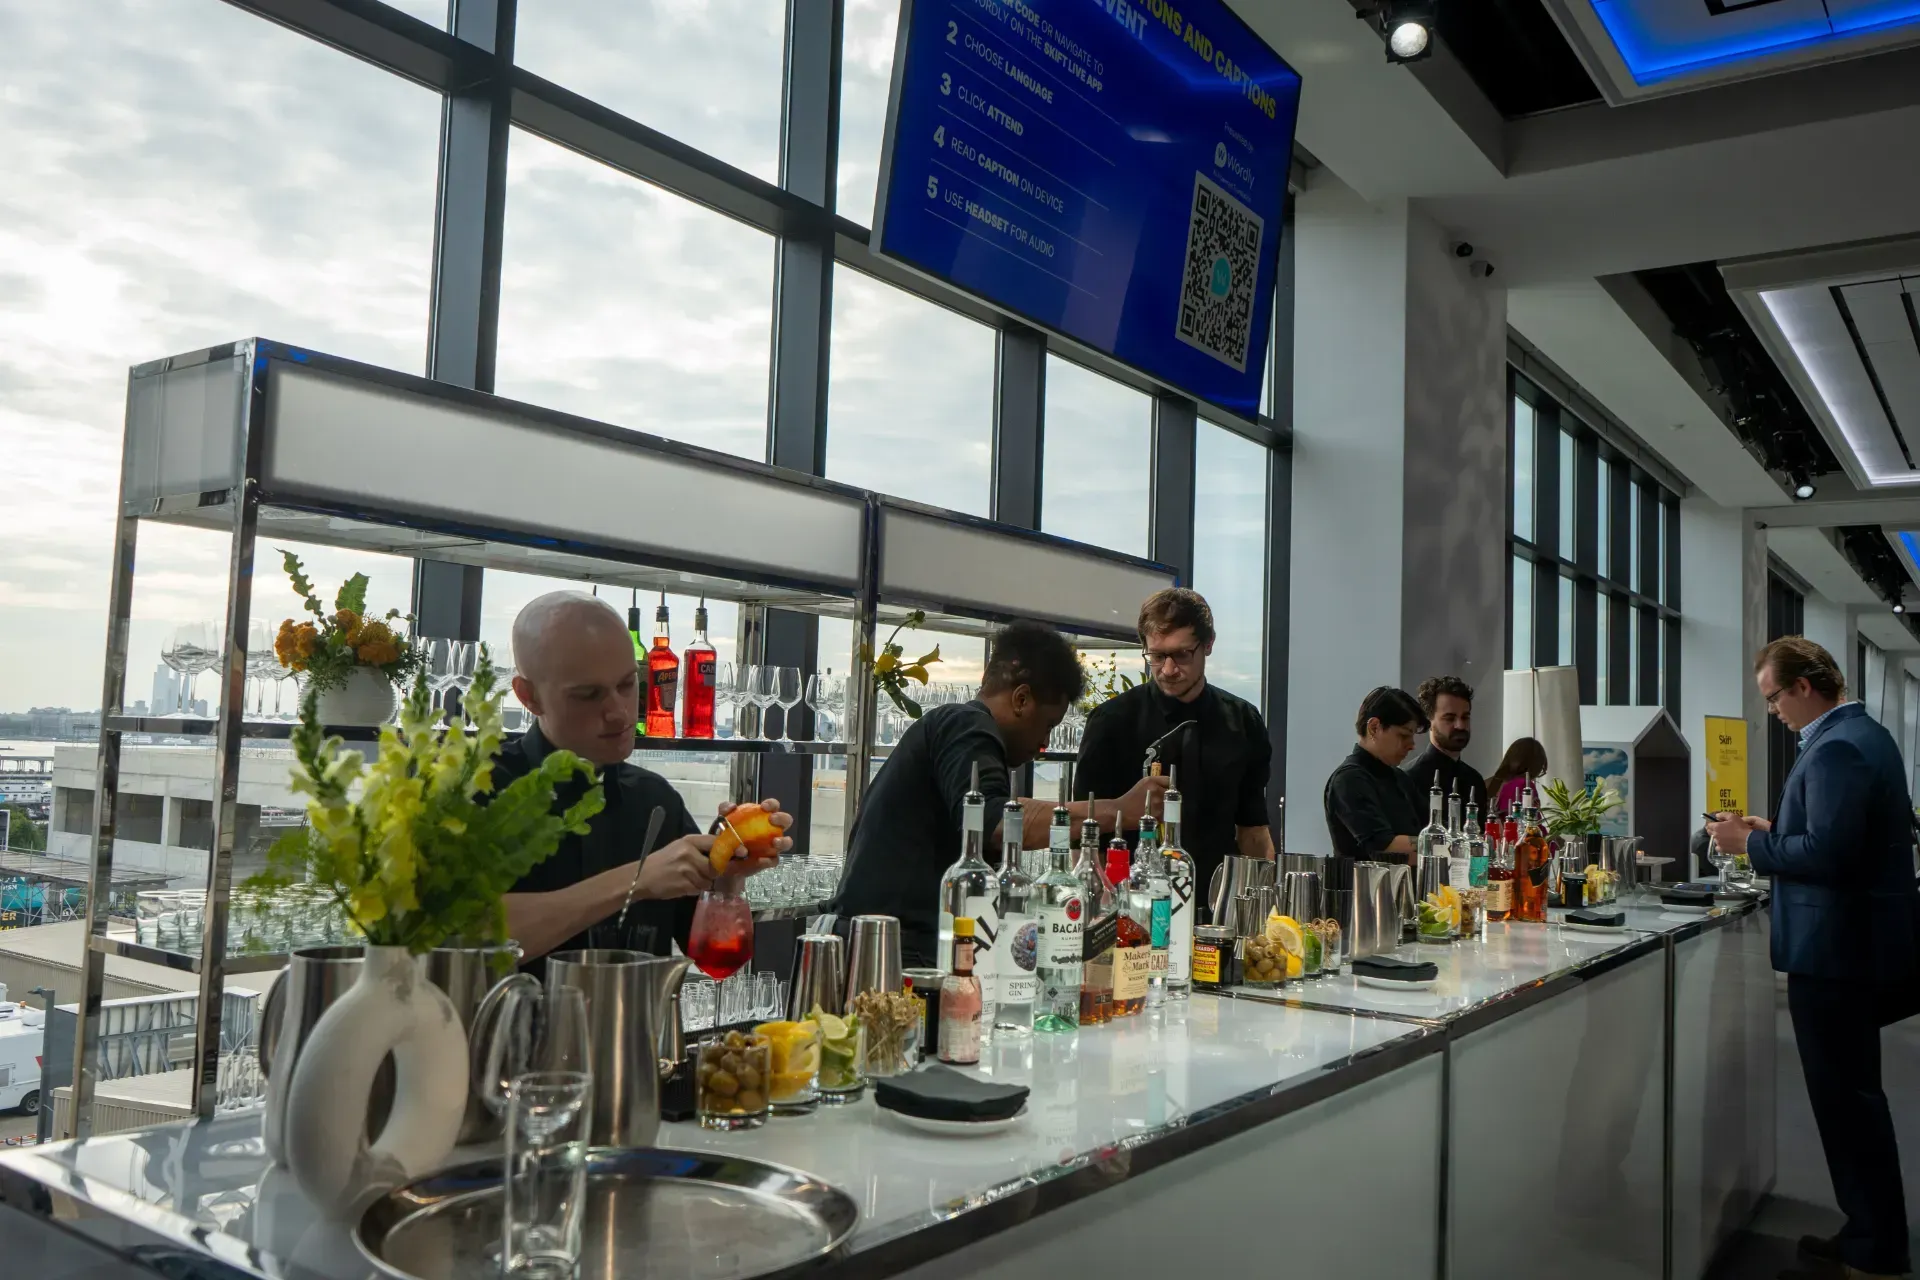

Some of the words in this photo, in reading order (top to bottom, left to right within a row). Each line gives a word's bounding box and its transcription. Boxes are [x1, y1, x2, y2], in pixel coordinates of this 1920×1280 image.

[946, 20, 958, 45] 2
[964, 34, 1004, 71] CHOOSE
[1005, 61, 1054, 104] LANGUAGE
[975, 0, 1009, 24] ORDLY
[1011, 17, 1024, 37] ON
[1026, 27, 1042, 51] THE
[1043, 42, 1068, 67] SKIFT
[1068, 60, 1087, 83] LIVE
[1086, 74, 1103, 92] APP
[1015, 0, 1040, 28] CODE
[1041, 20, 1053, 36] OR
[1055, 30, 1092, 67] NAVIGATE
[1094, 58, 1104, 75] TO
[1139, 0, 1182, 36] IONS
[1184, 22, 1213, 63] AND
[1215, 50, 1276, 119] CAPTIONS
[940, 72, 951, 96] 3
[958, 85, 986, 114] CLICK
[987, 104, 1024, 137] ATTEND
[933, 125, 945, 148] 4
[951, 137, 976, 162] READ
[978, 153, 1020, 188] CAPTION
[1020, 177, 1034, 196] ON
[1035, 186, 1064, 214] DEVICE
[1227, 152, 1255, 190] Wordly
[926, 175, 939, 199] 5
[944, 188, 964, 211] USE
[965, 200, 1010, 233] HEADSET
[1010, 224, 1028, 244] FOR
[1028, 235, 1055, 258] AUDIO
[1718, 734, 1732, 745] Skift
[1719, 789, 1731, 798] GET
[1720, 799, 1737, 808] TEAM
[1052, 923, 1084, 933] BACAR
[1132, 960, 1150, 970] Mark
